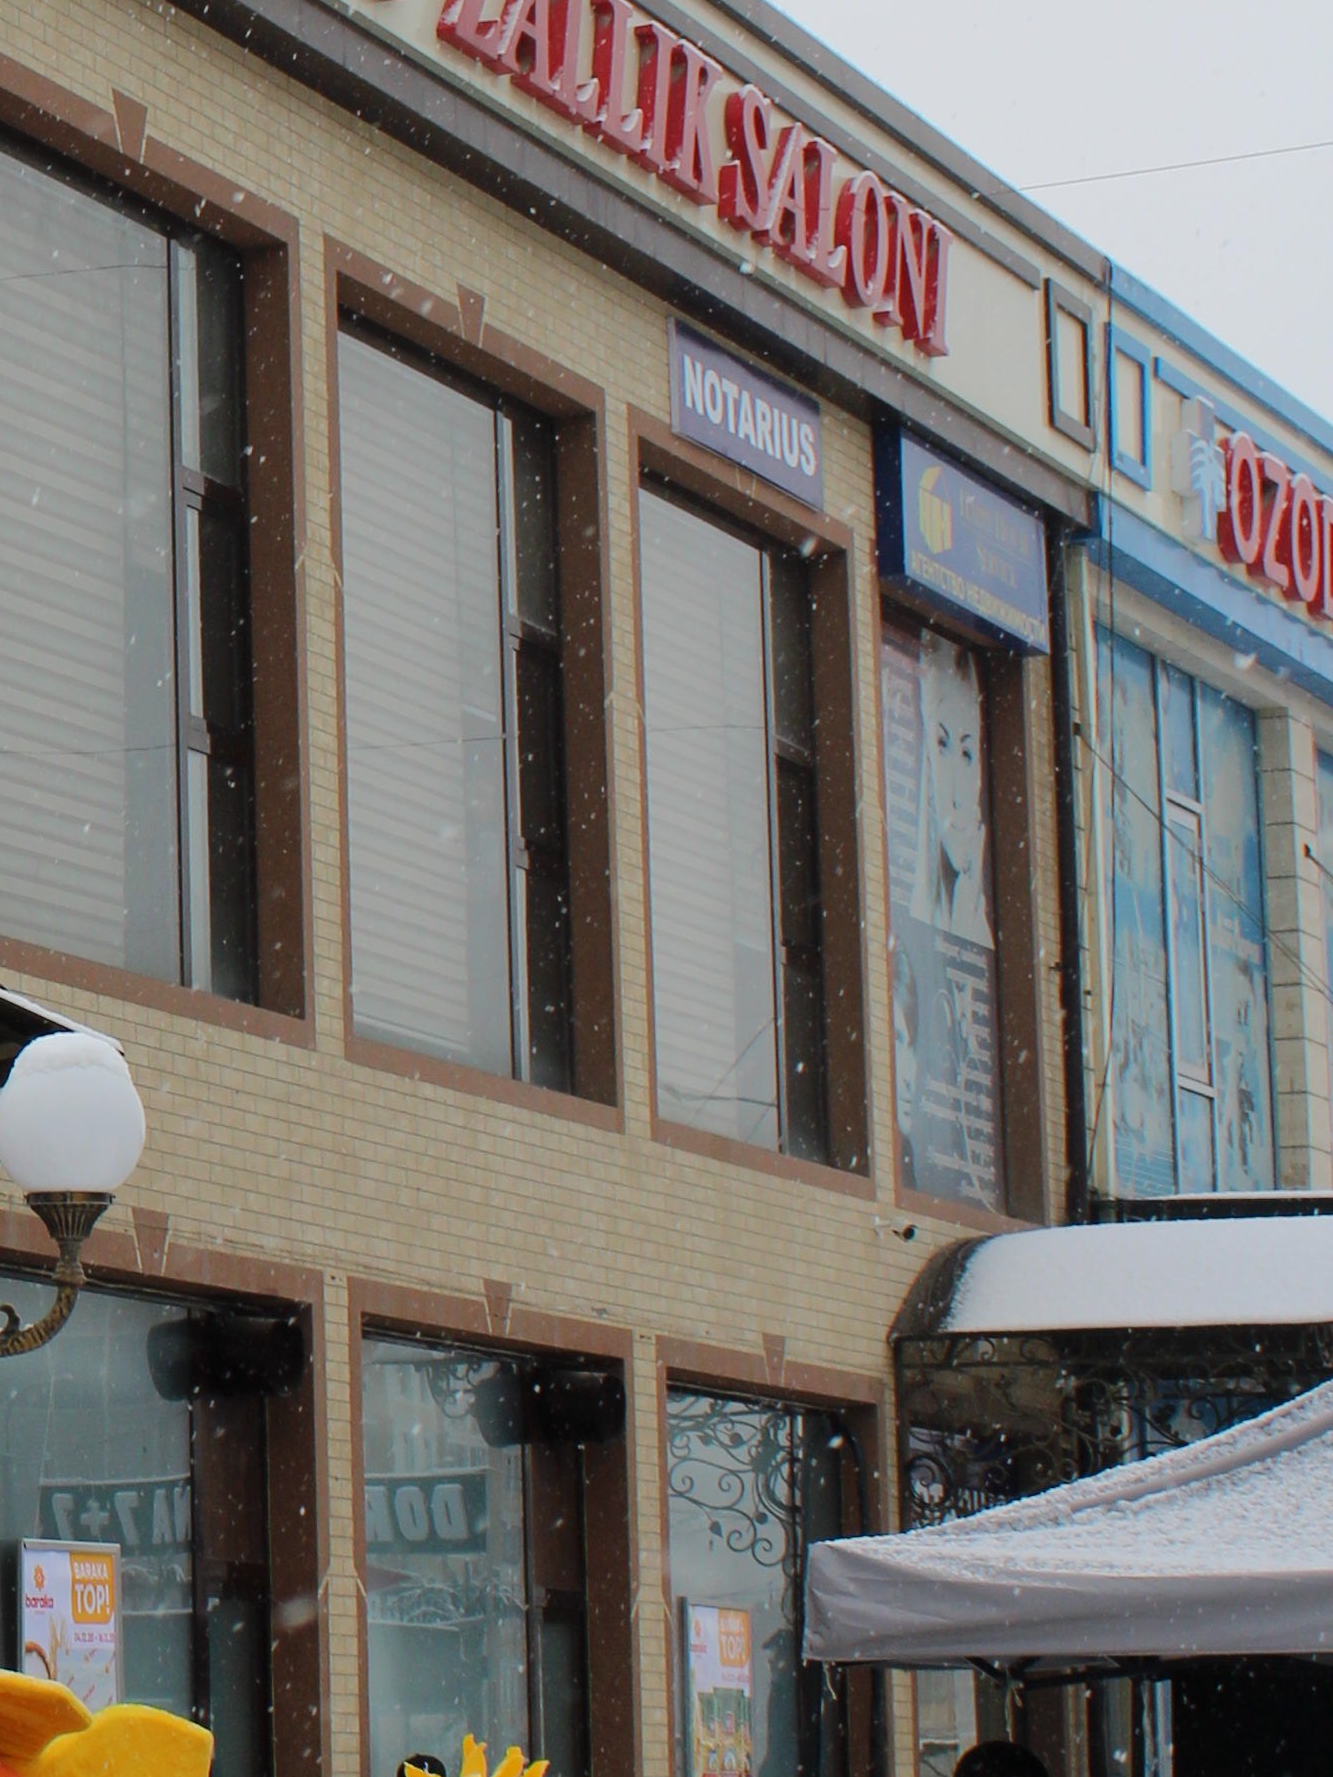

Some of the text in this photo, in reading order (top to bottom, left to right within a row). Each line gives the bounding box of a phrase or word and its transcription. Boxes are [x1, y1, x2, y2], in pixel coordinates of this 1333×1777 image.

[718, 83, 952, 357] SALONI
[683, 353, 818, 477] NOTARIUS
[1217, 430, 1333, 627] OZO
[25, 1593, 54, 1610] baraka
[73, 1561, 109, 1580] BARAKA
[74, 1582, 111, 1615] TOP!
